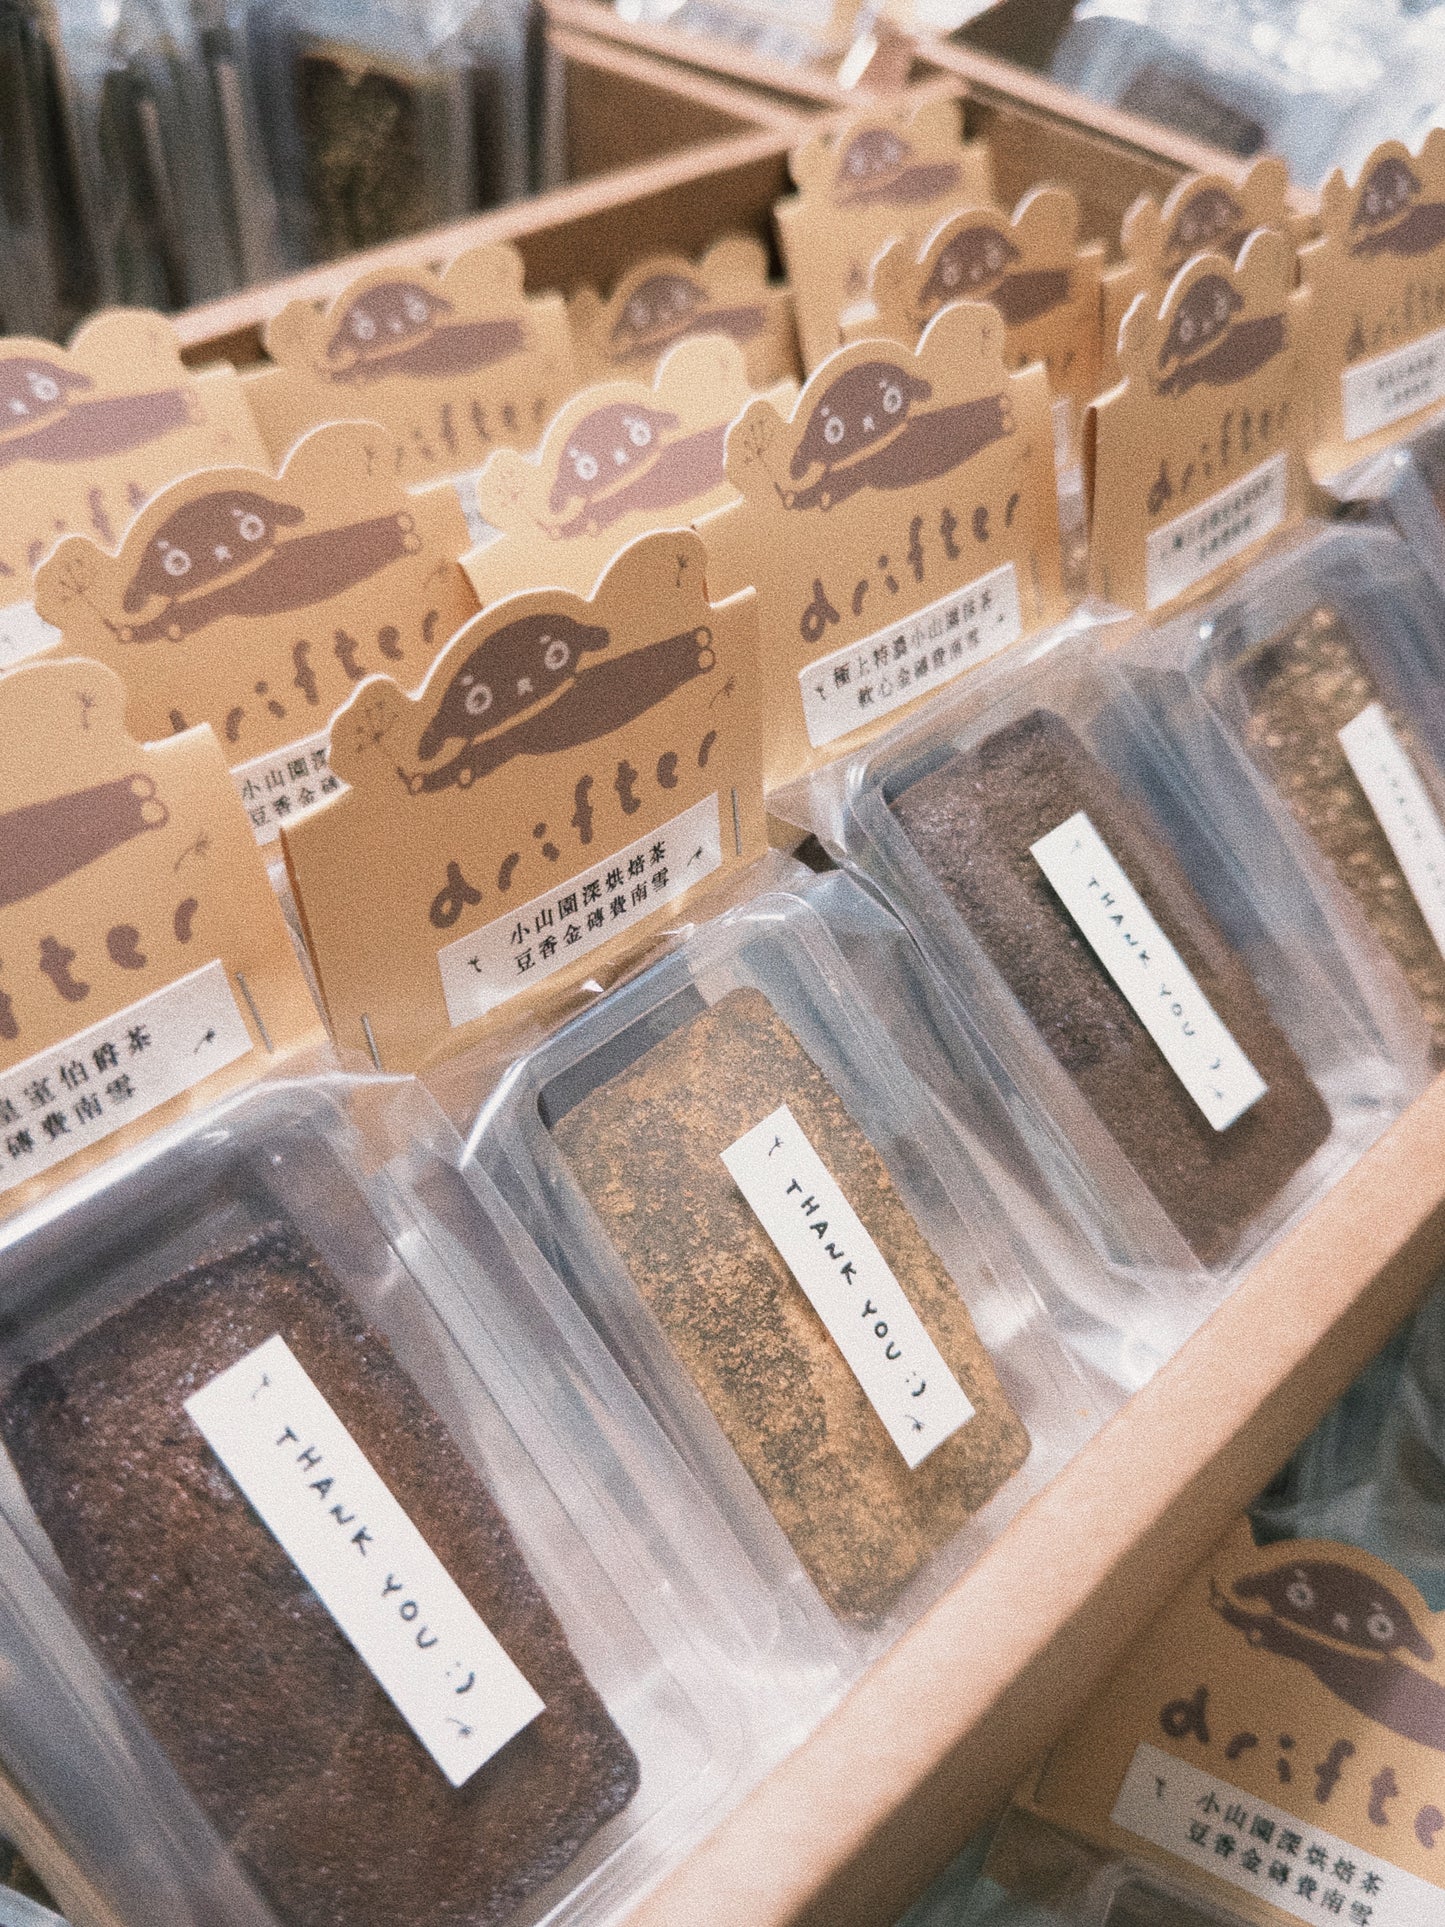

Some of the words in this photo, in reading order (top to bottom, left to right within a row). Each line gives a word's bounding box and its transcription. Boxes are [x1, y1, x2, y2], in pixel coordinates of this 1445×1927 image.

[800, 492, 1020, 643] drifter
[429, 730, 718, 928] drifter
[509, 840, 667, 946] 小山園深烘焙茶
[515, 867, 670, 975] 豆香金磚費南雪
[1088, 877, 1150, 969] THANK
[1160, 984, 1196, 1037] YOU
[786, 1178, 856, 1286] THANK
[861, 1300, 902, 1361] YOU
[276, 1426, 374, 1557] THANK
[382, 1574, 438, 1649] YOU
